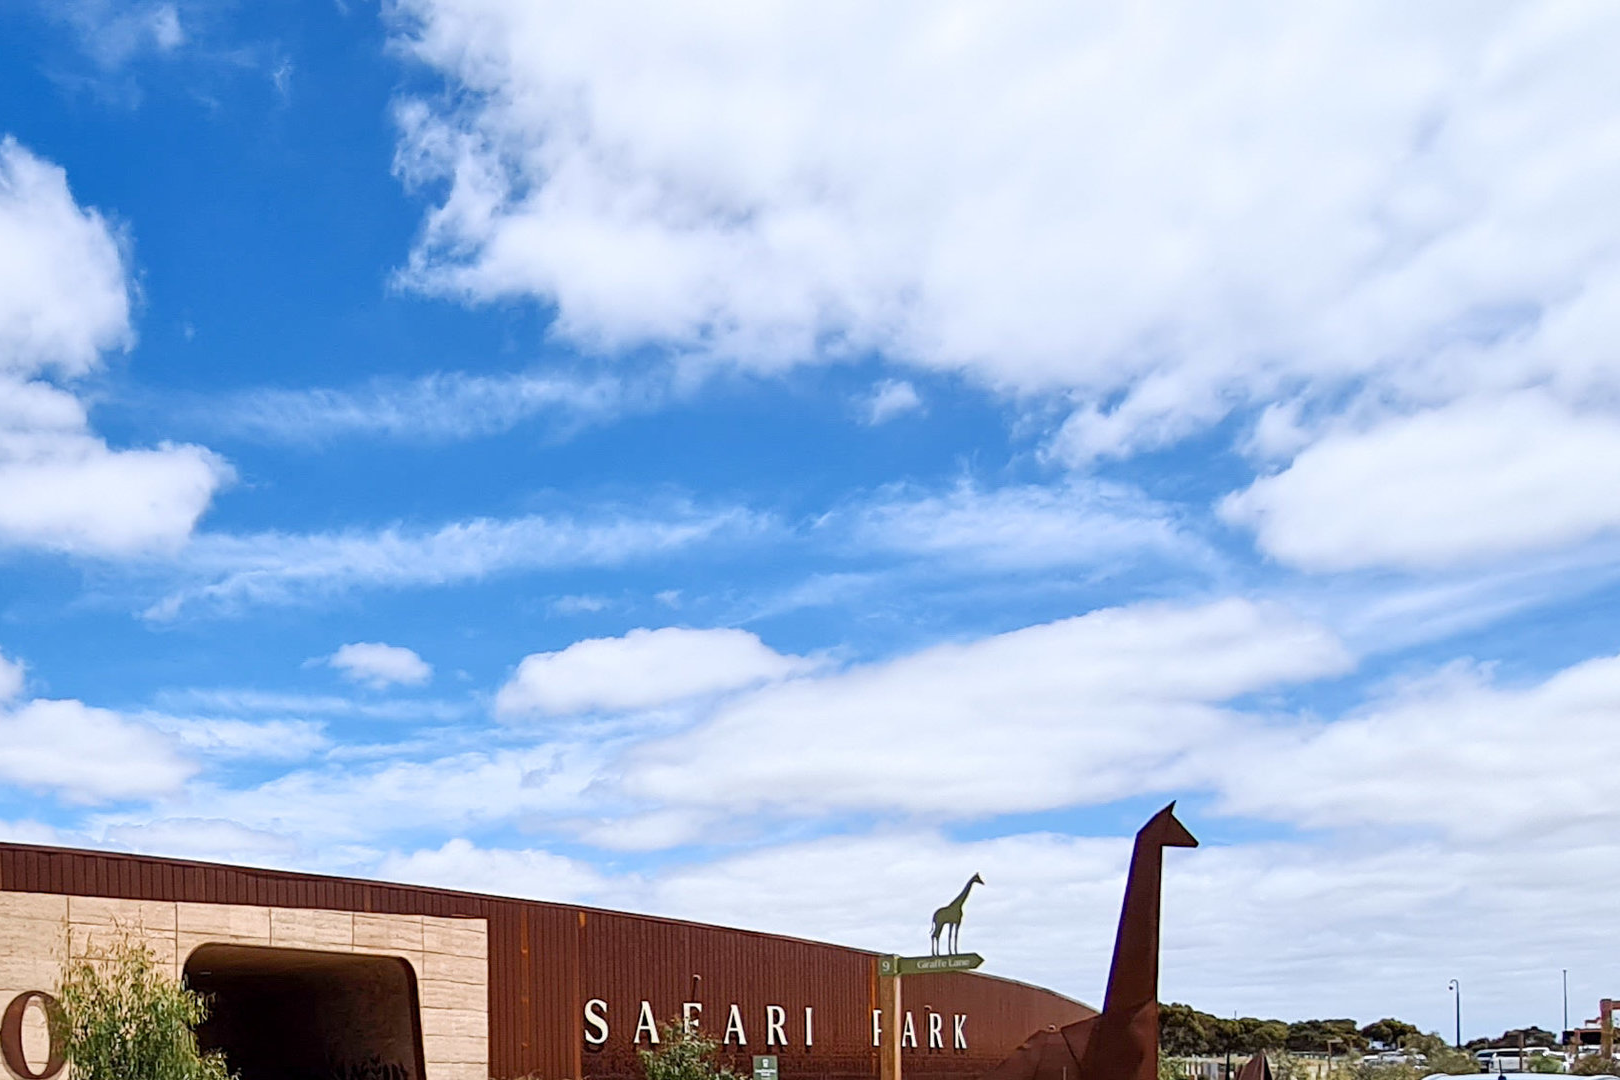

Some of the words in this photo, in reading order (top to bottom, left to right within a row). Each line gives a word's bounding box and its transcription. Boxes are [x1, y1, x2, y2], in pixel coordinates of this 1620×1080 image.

[882, 961, 890, 972] 9
[916, 959, 947, 969] Giraffe
[948, 959, 970, 968] Lane
[584, 999, 813, 1046] SAFARI
